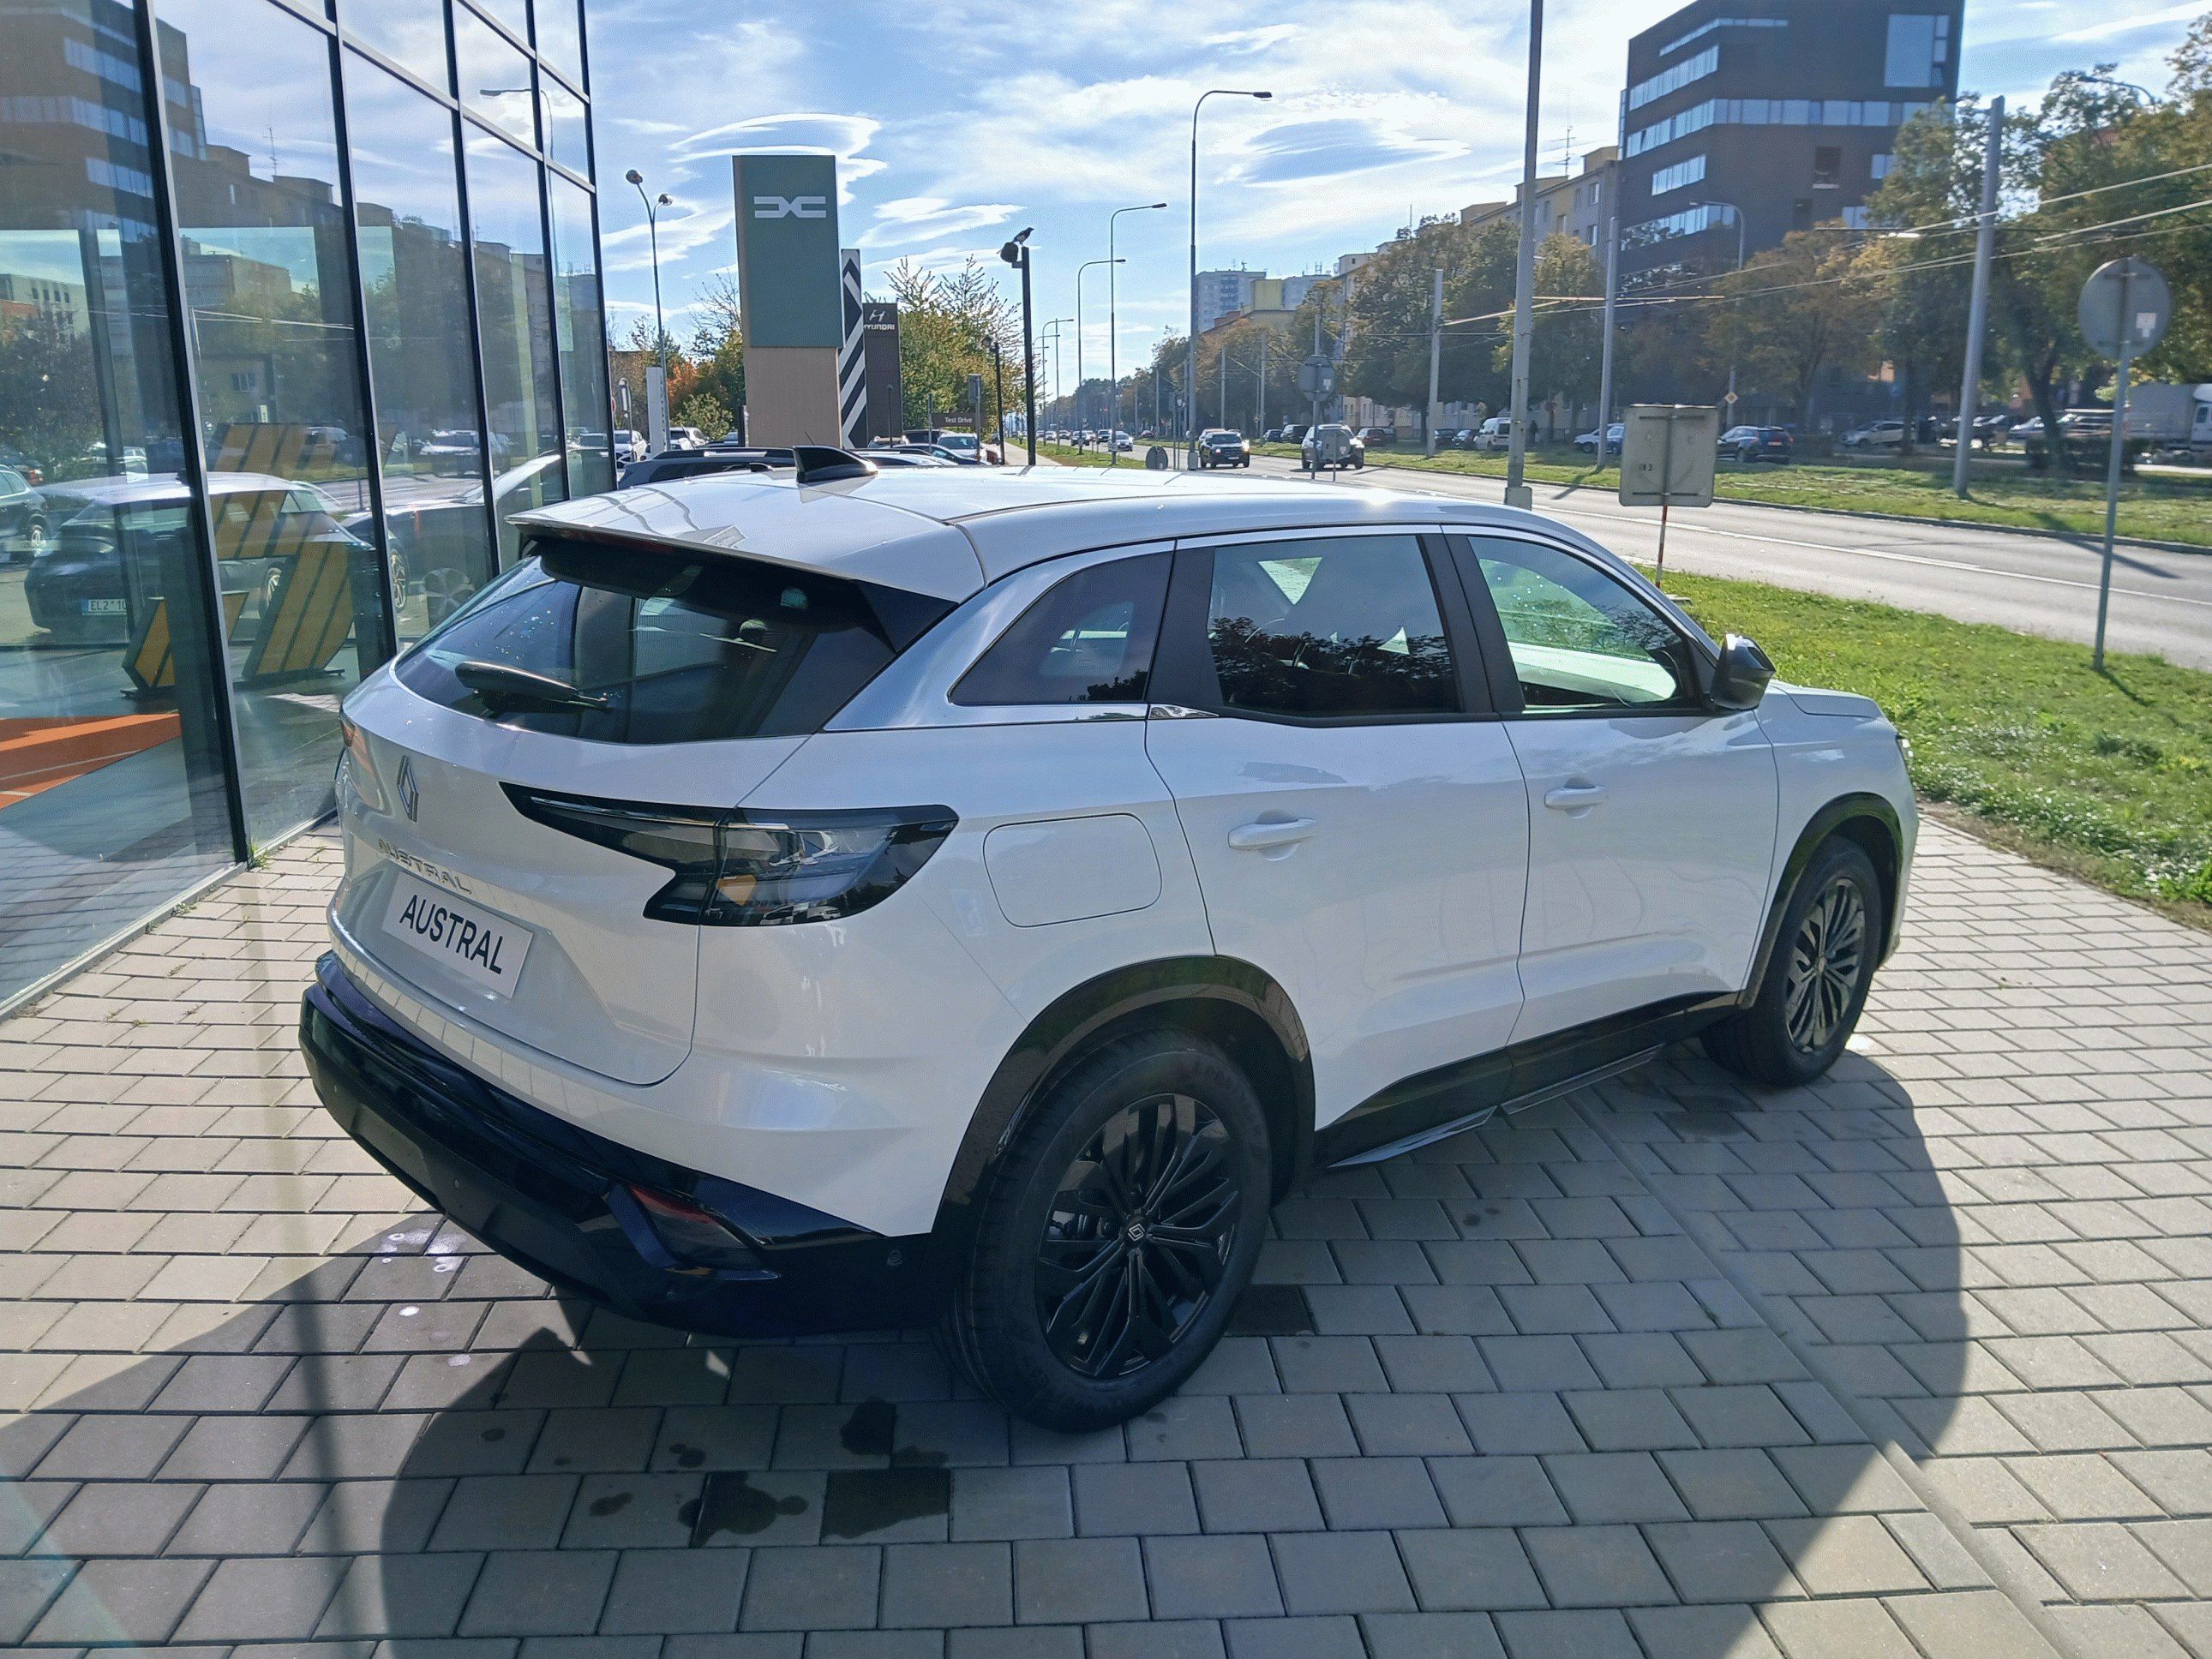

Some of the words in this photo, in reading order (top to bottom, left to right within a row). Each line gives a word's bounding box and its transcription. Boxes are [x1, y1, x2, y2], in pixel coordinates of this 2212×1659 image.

[90, 601, 109, 610] EL2
[379, 838, 472, 895] AUSTRAL
[399, 894, 504, 975] AUSTRAL
